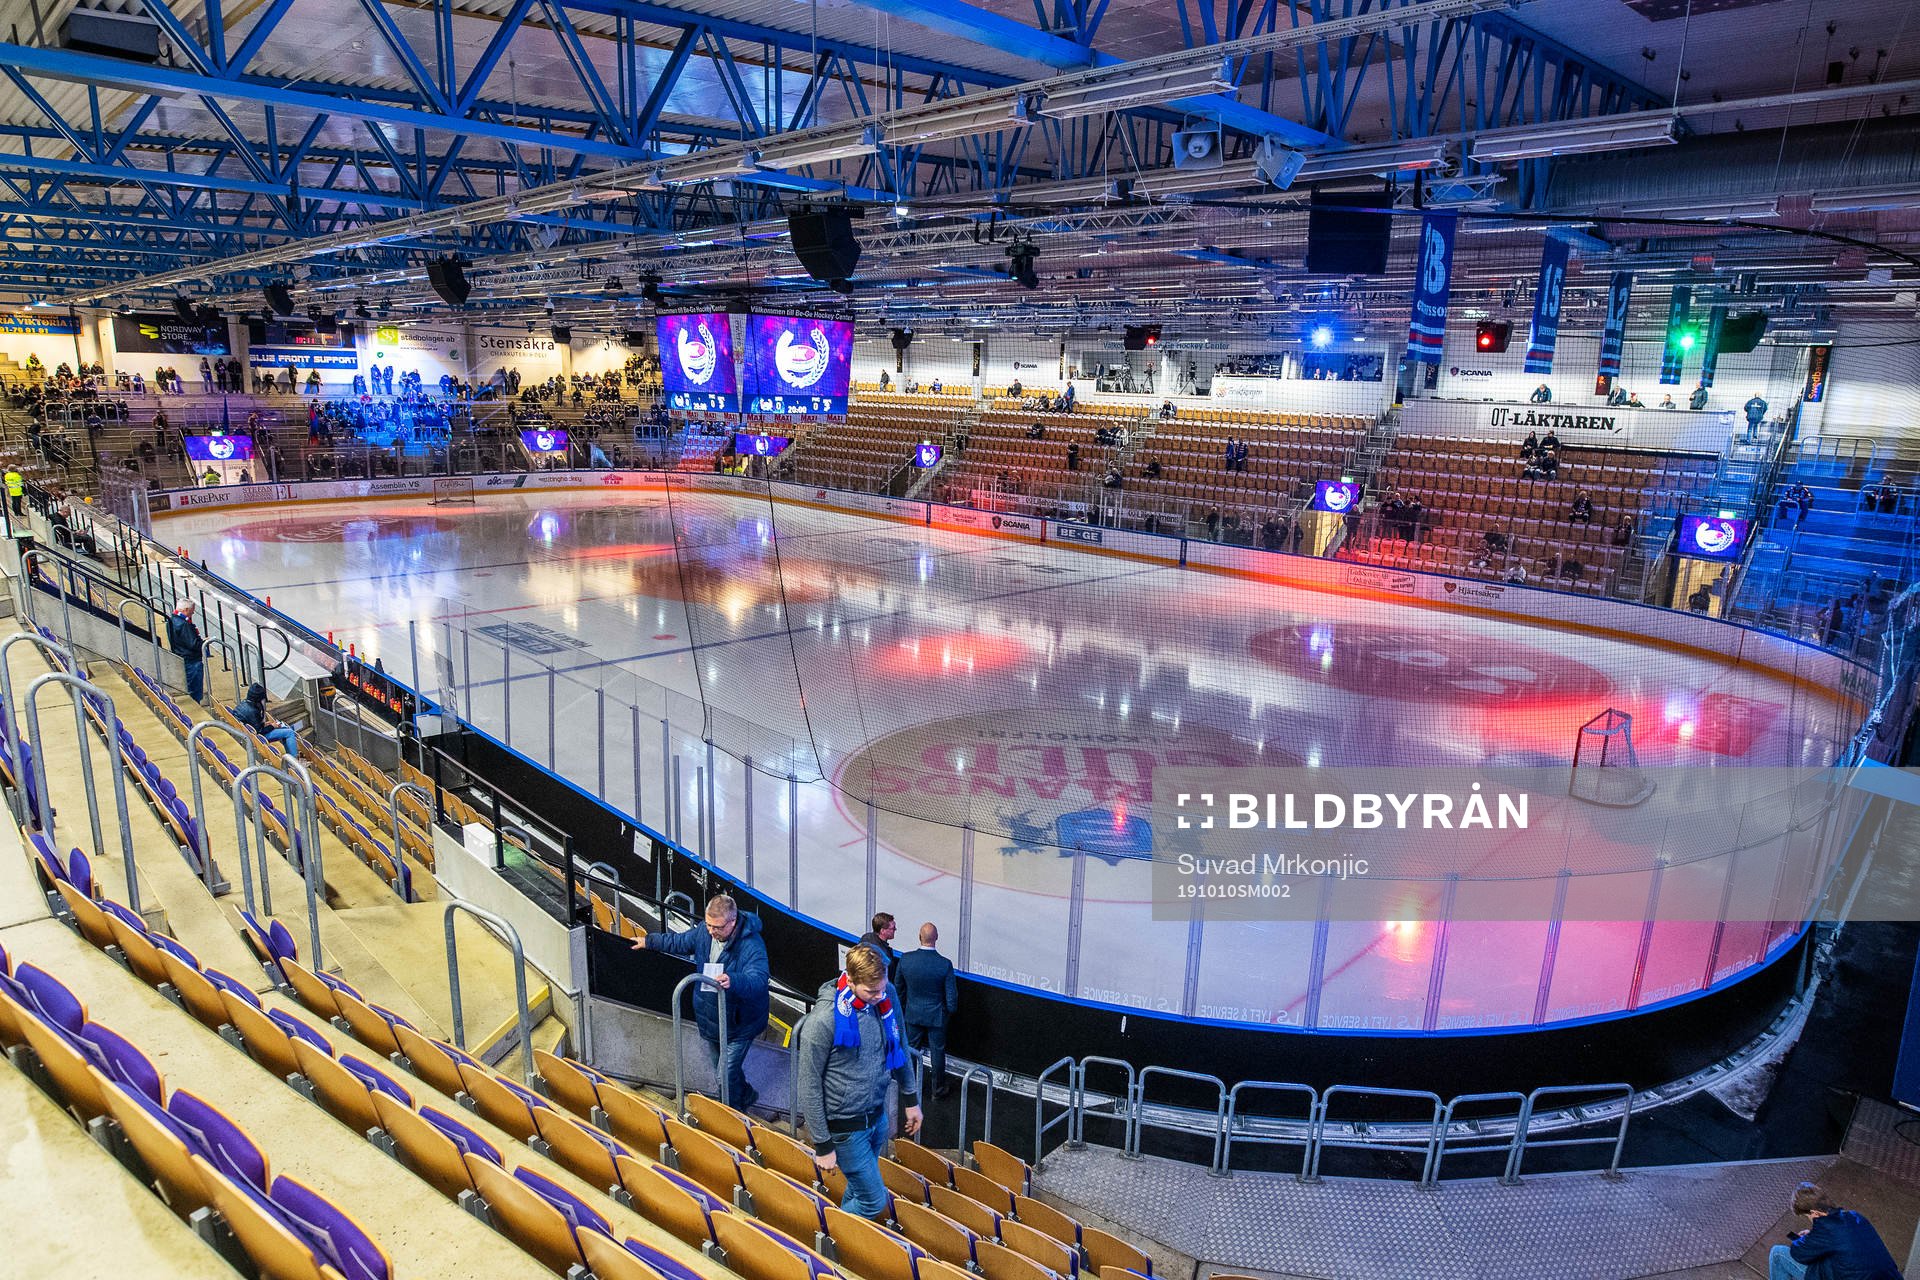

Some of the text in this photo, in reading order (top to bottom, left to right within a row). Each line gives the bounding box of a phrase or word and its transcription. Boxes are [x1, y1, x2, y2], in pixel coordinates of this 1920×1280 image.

[1541, 263, 1563, 317] 15
[750, 305, 854, 321] Välkommen till Be-Ge Hockey Center
[16, 317, 67, 327] VIKTORIA
[160, 325, 202, 334] NORDWAY
[401, 333, 455, 344] städbolaget ab
[480, 335, 555, 350] Stensåkra
[1176, 342, 1202, 351] Hockey
[1205, 342, 1230, 350] Center
[278, 354, 310, 363] FRONT
[313, 356, 357, 364] SUPPORT
[1460, 369, 1492, 377] SCANIA
[1808, 355, 1825, 401] Swedbank
[788, 406, 807, 414] 20:00
[747, 414, 843, 422] MAXI MAXI MAXI MAXI
[1491, 408, 1615, 432] OT-LÄKTAREN
[370, 480, 420, 490] Assemblin VS
[276, 484, 298, 500] EL
[1002, 520, 1031, 531] SCANIA
[1060, 528, 1099, 542] BE-GE
